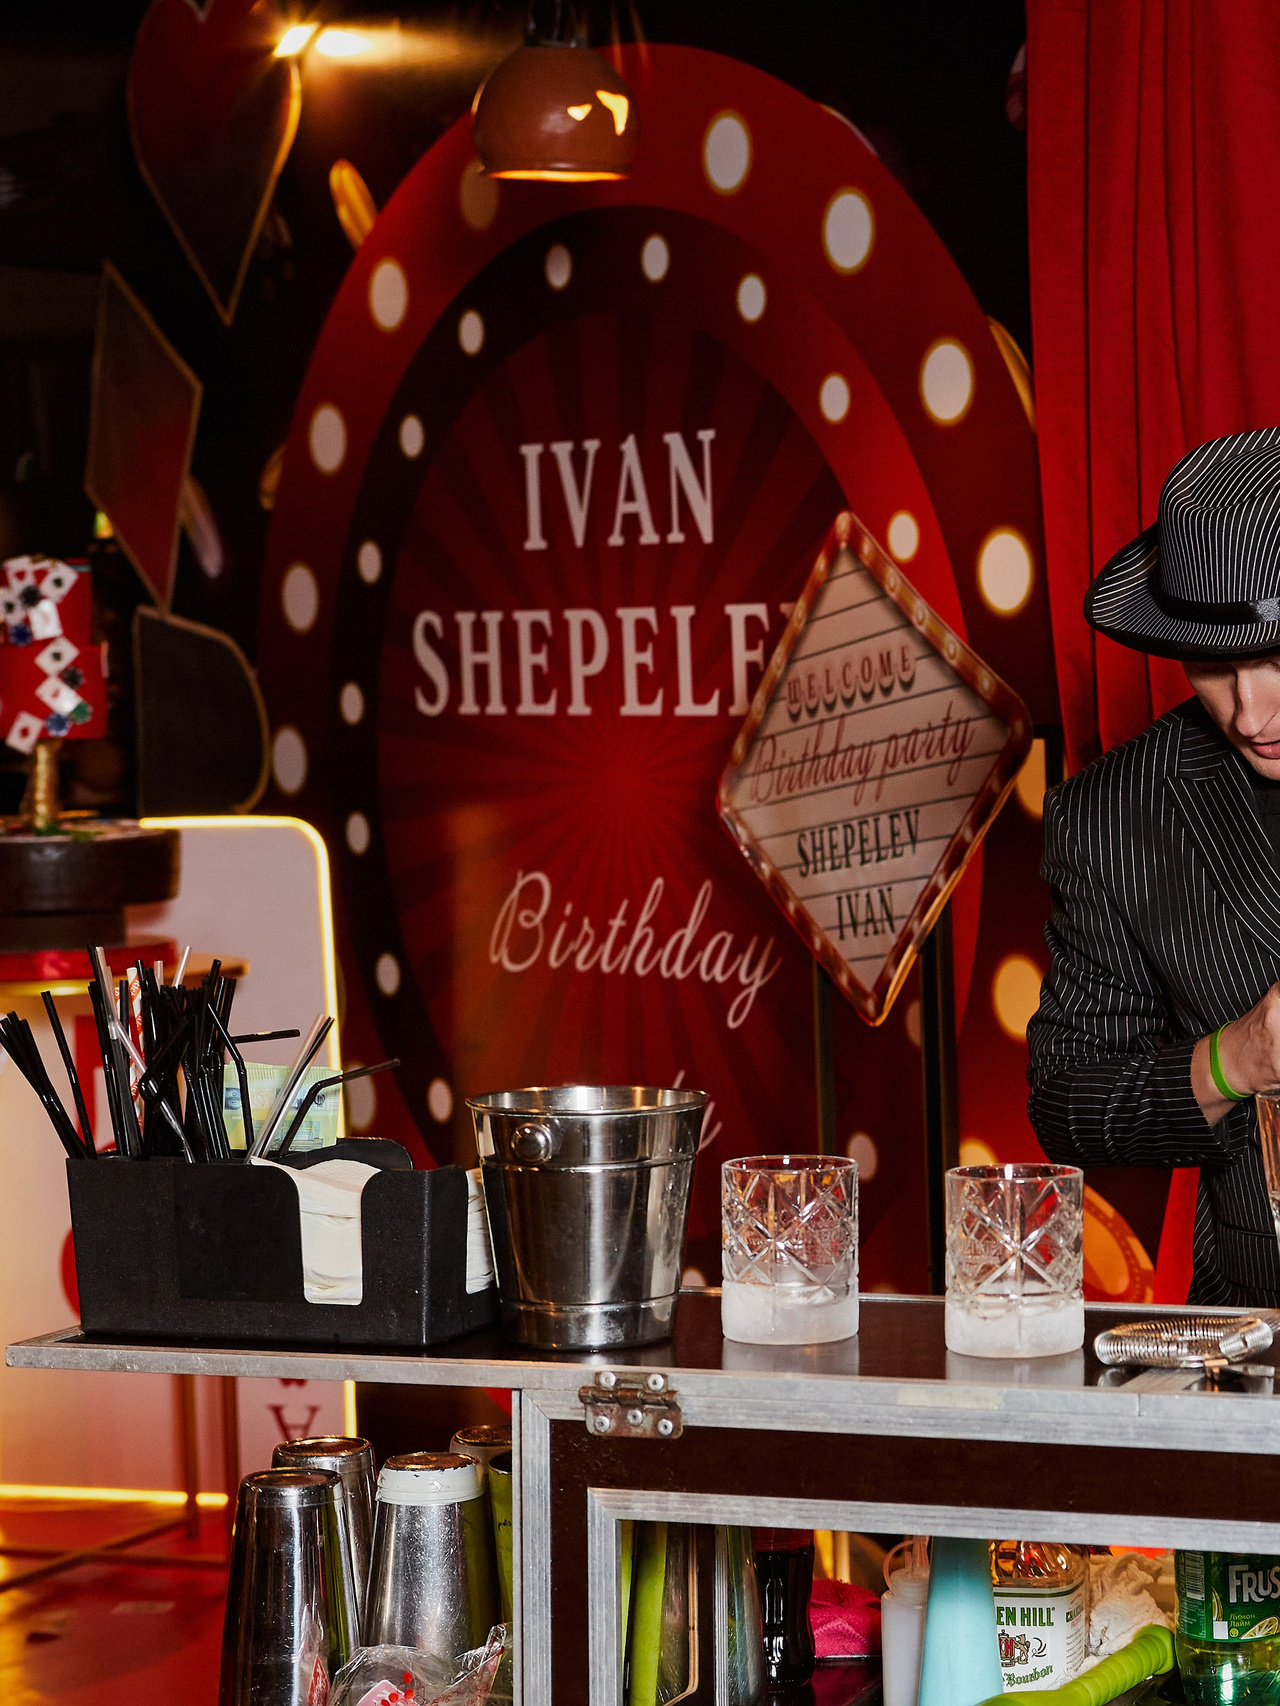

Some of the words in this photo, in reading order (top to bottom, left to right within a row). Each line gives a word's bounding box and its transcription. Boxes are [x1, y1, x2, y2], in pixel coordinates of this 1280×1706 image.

[519, 428, 716, 551] IVAN
[412, 601, 798, 717] SHEPELE
[787, 645, 914, 714] WELCOME
[752, 715, 876, 807] Birthday
[875, 701, 976, 802] party
[797, 809, 920, 878] SHEPELEV
[837, 887, 895, 941] IVAN
[490, 870, 784, 1030] Birthday
[997, 1606, 1016, 1626] EN
[1021, 1606, 1054, 1627] HILL
[1004, 1664, 1054, 1688] Bourbon
